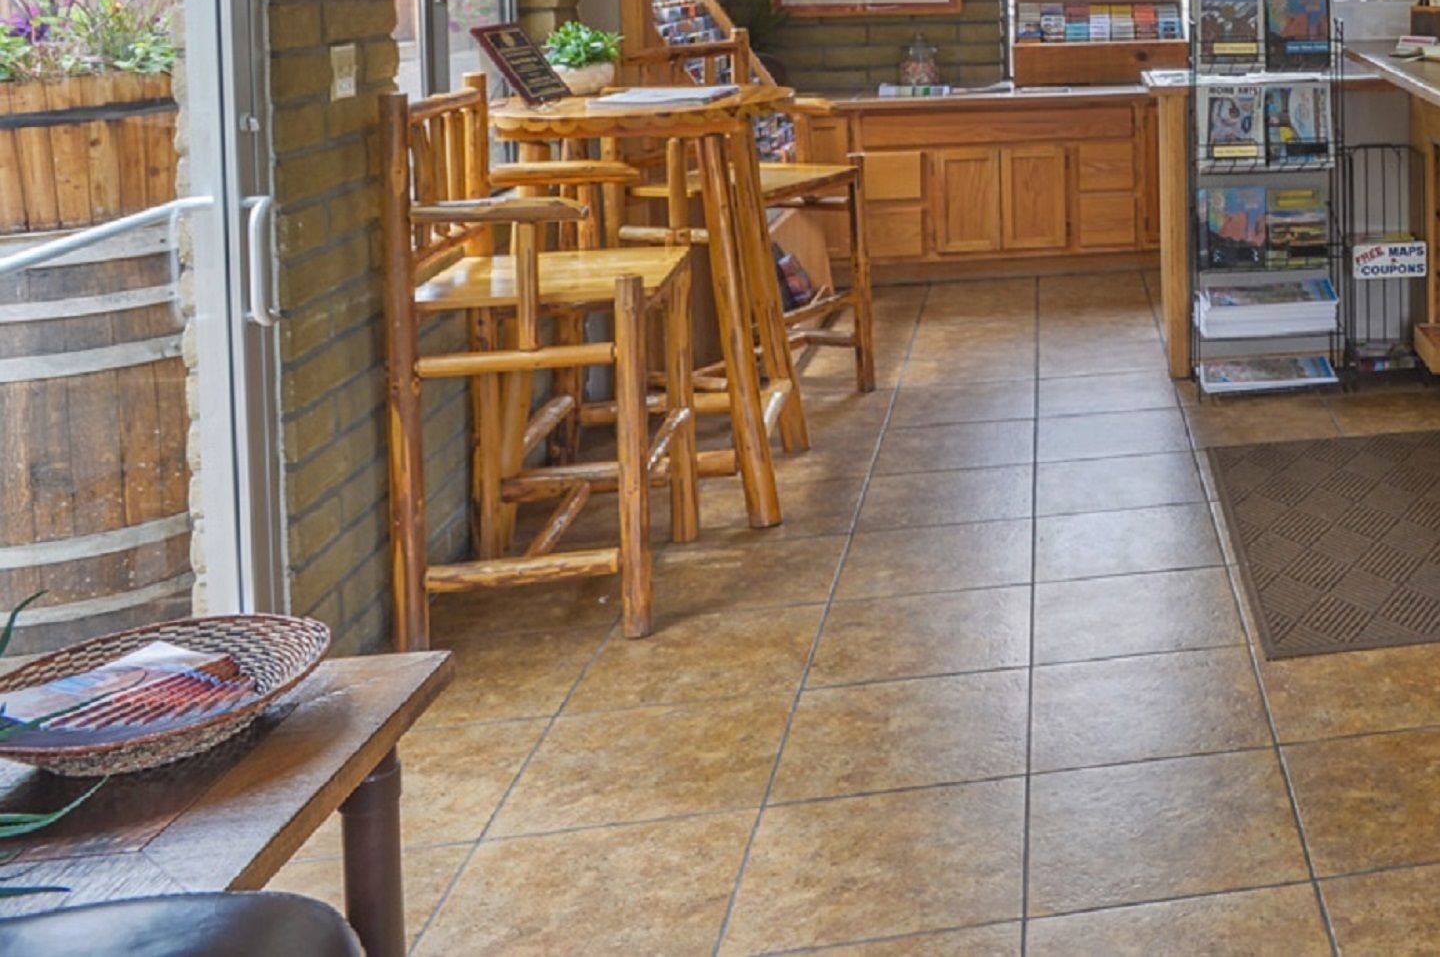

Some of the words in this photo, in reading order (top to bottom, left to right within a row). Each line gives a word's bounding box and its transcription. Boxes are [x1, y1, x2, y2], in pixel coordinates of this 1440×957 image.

[1355, 246, 1384, 265] FREE
[1388, 246, 1424, 257] MAPS
[1361, 264, 1424, 276] COUPONS
